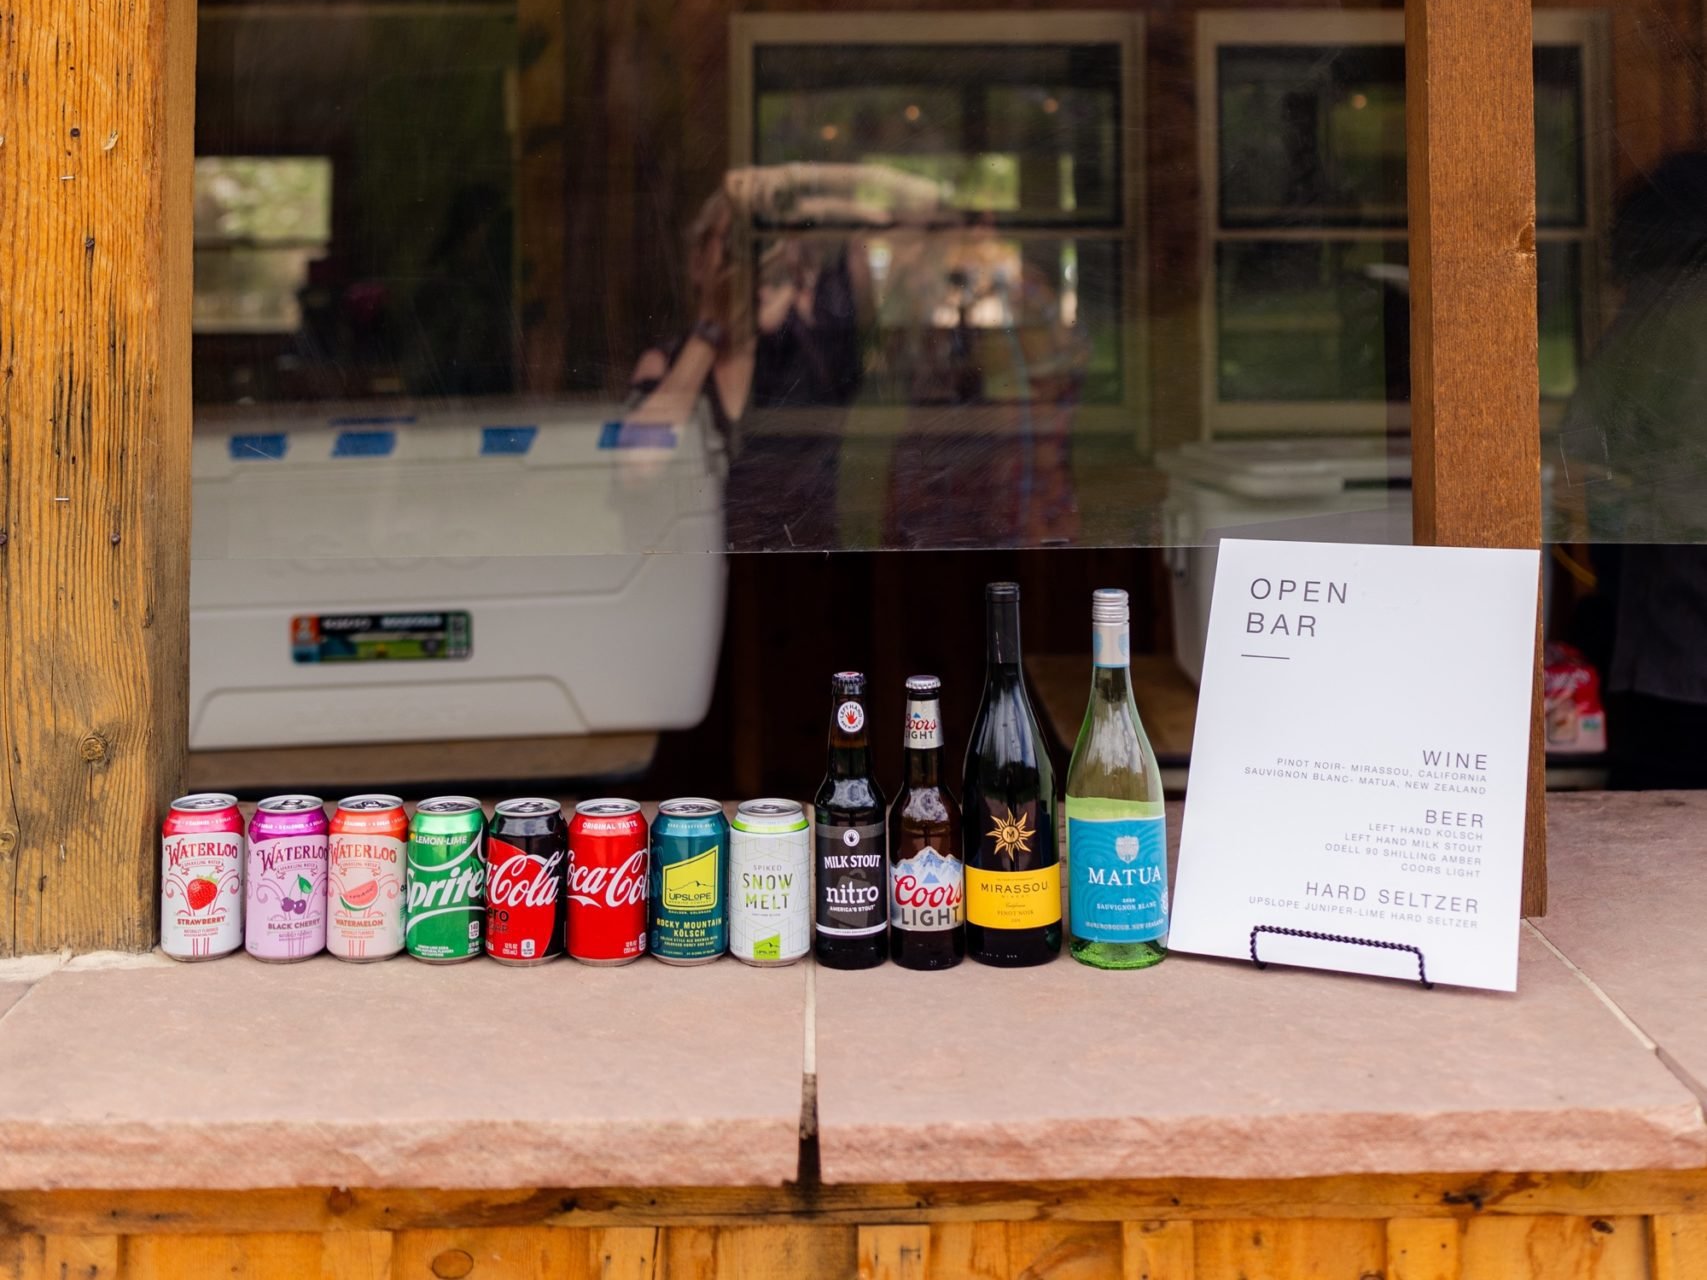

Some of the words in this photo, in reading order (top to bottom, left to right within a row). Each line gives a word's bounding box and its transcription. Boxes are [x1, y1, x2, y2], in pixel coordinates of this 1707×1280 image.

[1250, 577, 1347, 604] OPEN
[1246, 612, 1316, 637] BAR
[1422, 749, 1487, 770] WINE
[1277, 758, 1309, 768] PINOT
[1314, 761, 1345, 770] NOIR-
[1351, 764, 1413, 778] MIRASSOU,
[1418, 770, 1487, 782] CALIFORNIA
[1244, 766, 1308, 779] SAUVIGNON
[1313, 773, 1353, 783] BLANC-
[1359, 777, 1400, 789] MATUA,
[1405, 781, 1429, 790] NEW
[1434, 782, 1487, 795] ZEALAND
[583, 821, 616, 830] ORIGINAL
[618, 820, 638, 829] TASTE
[1425, 809, 1484, 828] BEER
[416, 834, 467, 845] LEMON-LIME
[1006, 830, 1015, 838] M
[1369, 823, 1396, 832] LEFT
[1400, 826, 1431, 836] HAND
[1436, 829, 1483, 841] KOLSCH
[1345, 833, 1371, 843] LEFT
[1376, 836, 1407, 846] HAND
[1412, 839, 1439, 849] MILK
[1444, 842, 1483, 853] STOUT
[165, 838, 238, 871] WATERLOO
[256, 842, 329, 877] WATERLOO
[329, 838, 397, 870] WATERLOO
[824, 855, 849, 869] MILK
[850, 854, 881, 868] STOUT
[1324, 843, 1360, 854] ODELL
[1366, 847, 1379, 856] 90
[1383, 849, 1437, 862] SHILLING
[1441, 854, 1482, 865] AMBER
[1088, 865, 1162, 886] MATUA
[1401, 863, 1441, 875] COORS
[1446, 868, 1481, 878] LIGHT
[742, 873, 793, 890] SNOW
[981, 882, 1048, 894] MIRASSOU
[669, 893, 712, 901] UPSLOPE
[826, 881, 879, 904] nitro
[894, 874, 963, 908] Coors
[1306, 881, 1366, 901] HARD
[1378, 889, 1479, 914] SELTZER
[745, 893, 790, 910] MELT
[829, 905, 857, 913] AMERICA'S
[858, 904, 875, 912] STOUT
[1096, 903, 1136, 911] SAUVIGNON
[1137, 901, 1157, 910] BLANC
[177, 916, 225, 926] STRAWBERRY
[902, 906, 960, 926] LIGHT
[1249, 895, 1300, 910] UPSLOPE
[1304, 902, 1385, 919] JUNIPER-LIME
[1391, 912, 1422, 923] HARD
[1426, 915, 1478, 929] SELTZER
[294, 918, 320, 929] CHERRY
[335, 919, 384, 928] WATERMELON
[656, 918, 680, 929] ROCKY
[684, 917, 722, 929] MOUNTAIN
[674, 928, 705, 938] KÖLSCH
